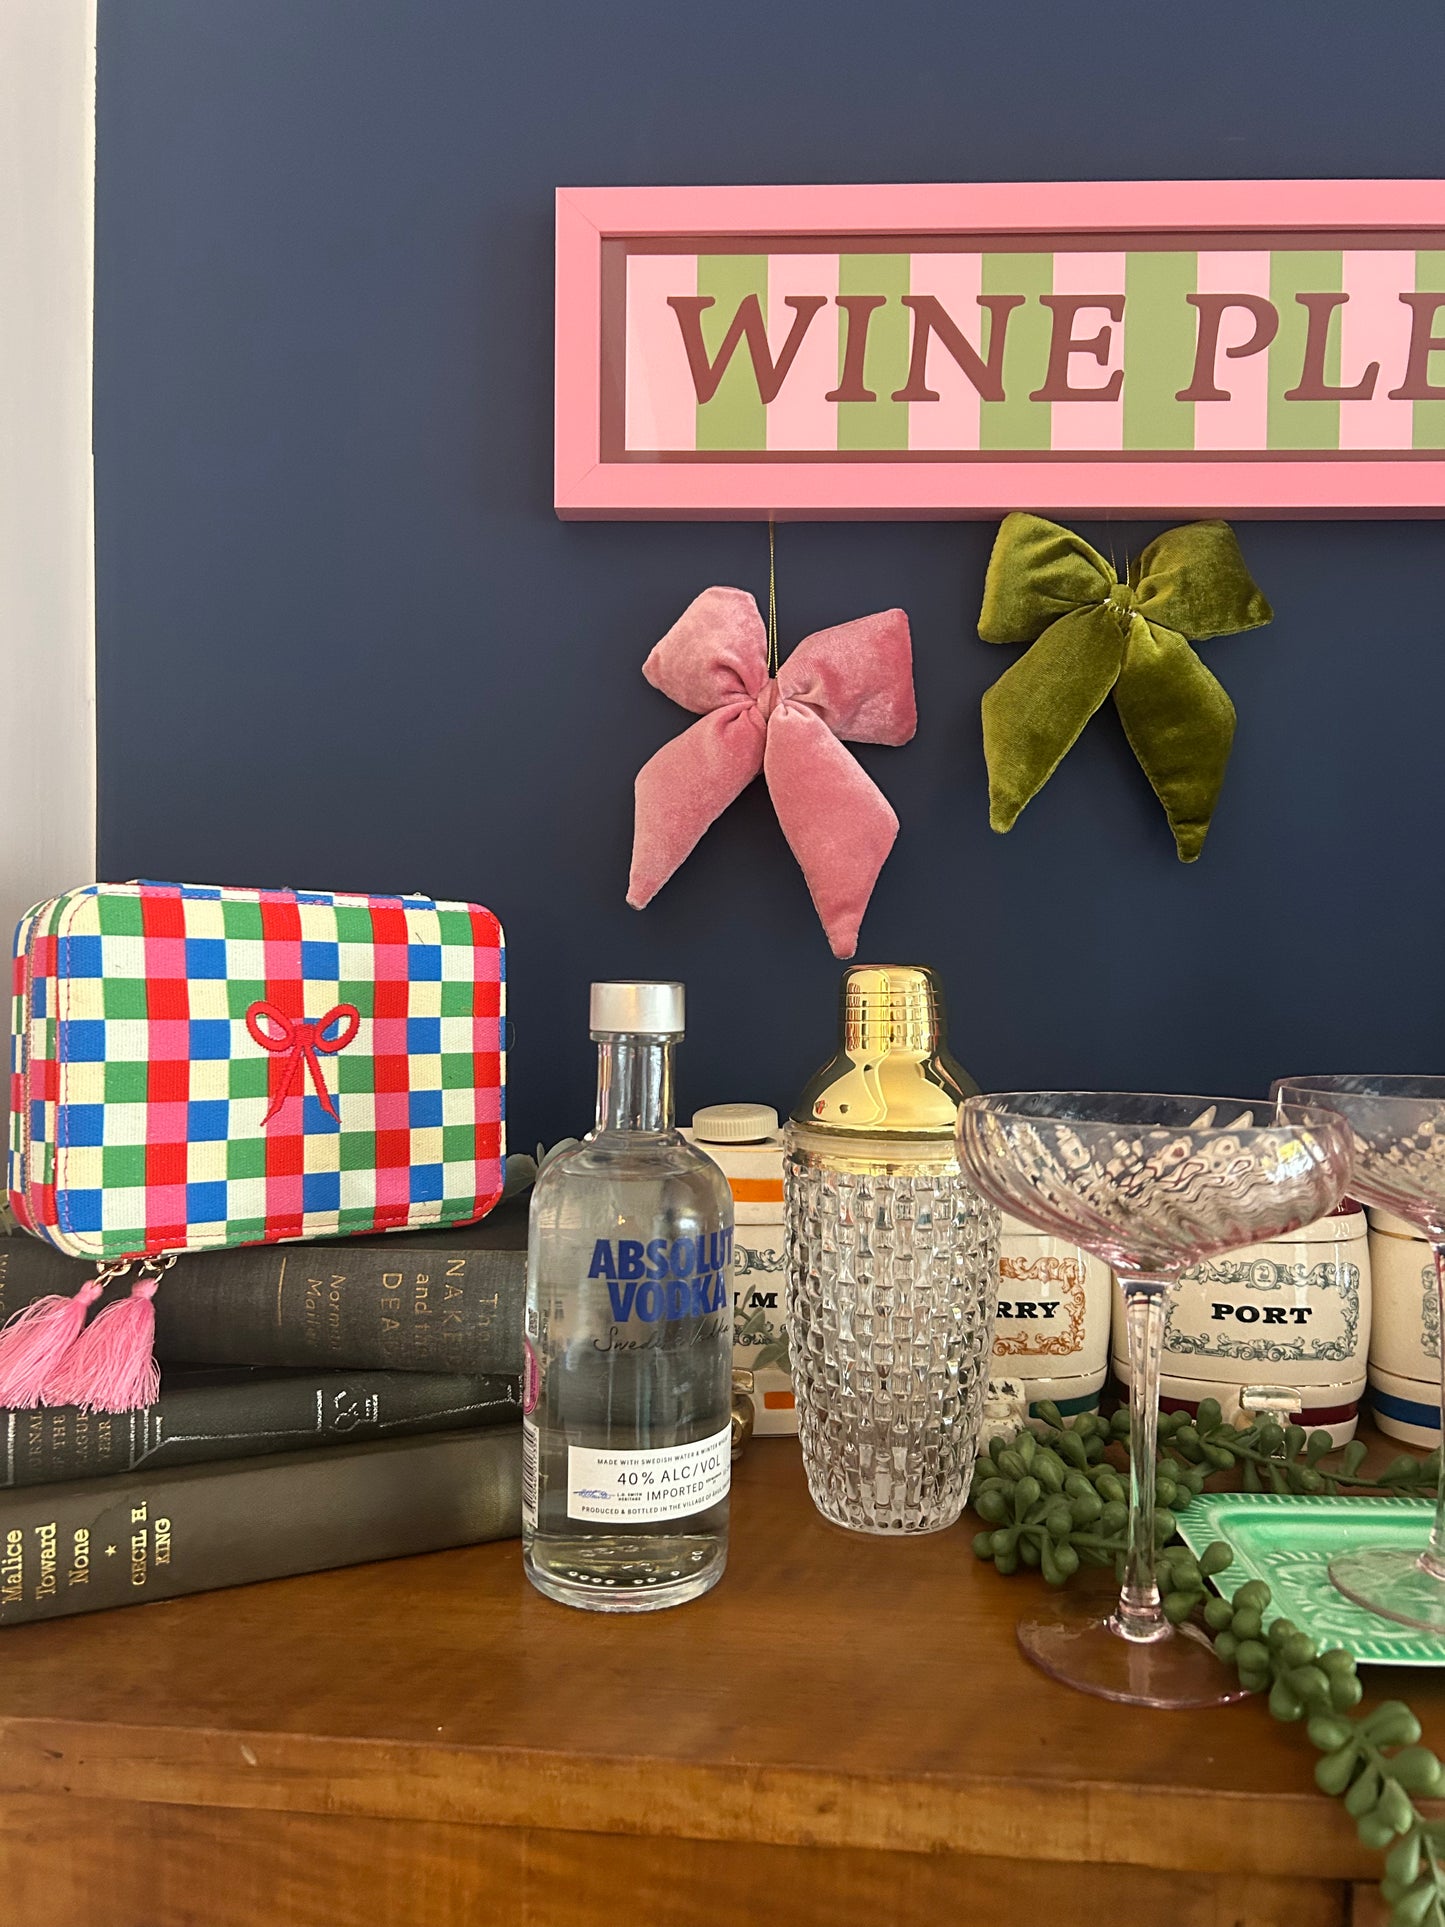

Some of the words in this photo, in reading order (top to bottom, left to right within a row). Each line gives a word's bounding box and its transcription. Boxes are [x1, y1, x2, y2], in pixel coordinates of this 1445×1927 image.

[667, 293, 1126, 405] WINE
[588, 1226, 734, 1281] ABSOLUT
[415, 1273, 433, 1315] and
[607, 1271, 727, 1323] VODKA
[996, 1301, 1060, 1318] RRY
[1211, 1302, 1313, 1325] PORT
[53, 1414, 66, 1450] THE
[597, 1458, 618, 1466] MADE
[641, 1456, 673, 1465] SWEDISH
[674, 1451, 695, 1461] WATER
[617, 1471, 655, 1486] 40%
[660, 1454, 721, 1483] ALC/VOL
[131, 1501, 147, 1523] H.
[581, 1505, 619, 1515] PRODUCED
[627, 1507, 659, 1515] BOTTLED
[669, 1503, 681, 1511] THE
[683, 1496, 704, 1508] VILLAGE
[646, 1481, 704, 1502] IMPORTED
[35, 1522, 57, 1599] Toward
[69, 1528, 90, 1585] None
[131, 1529, 147, 1586] CECIL
[155, 1518, 171, 1566] KING
[1, 1529, 23, 1604] Malice
